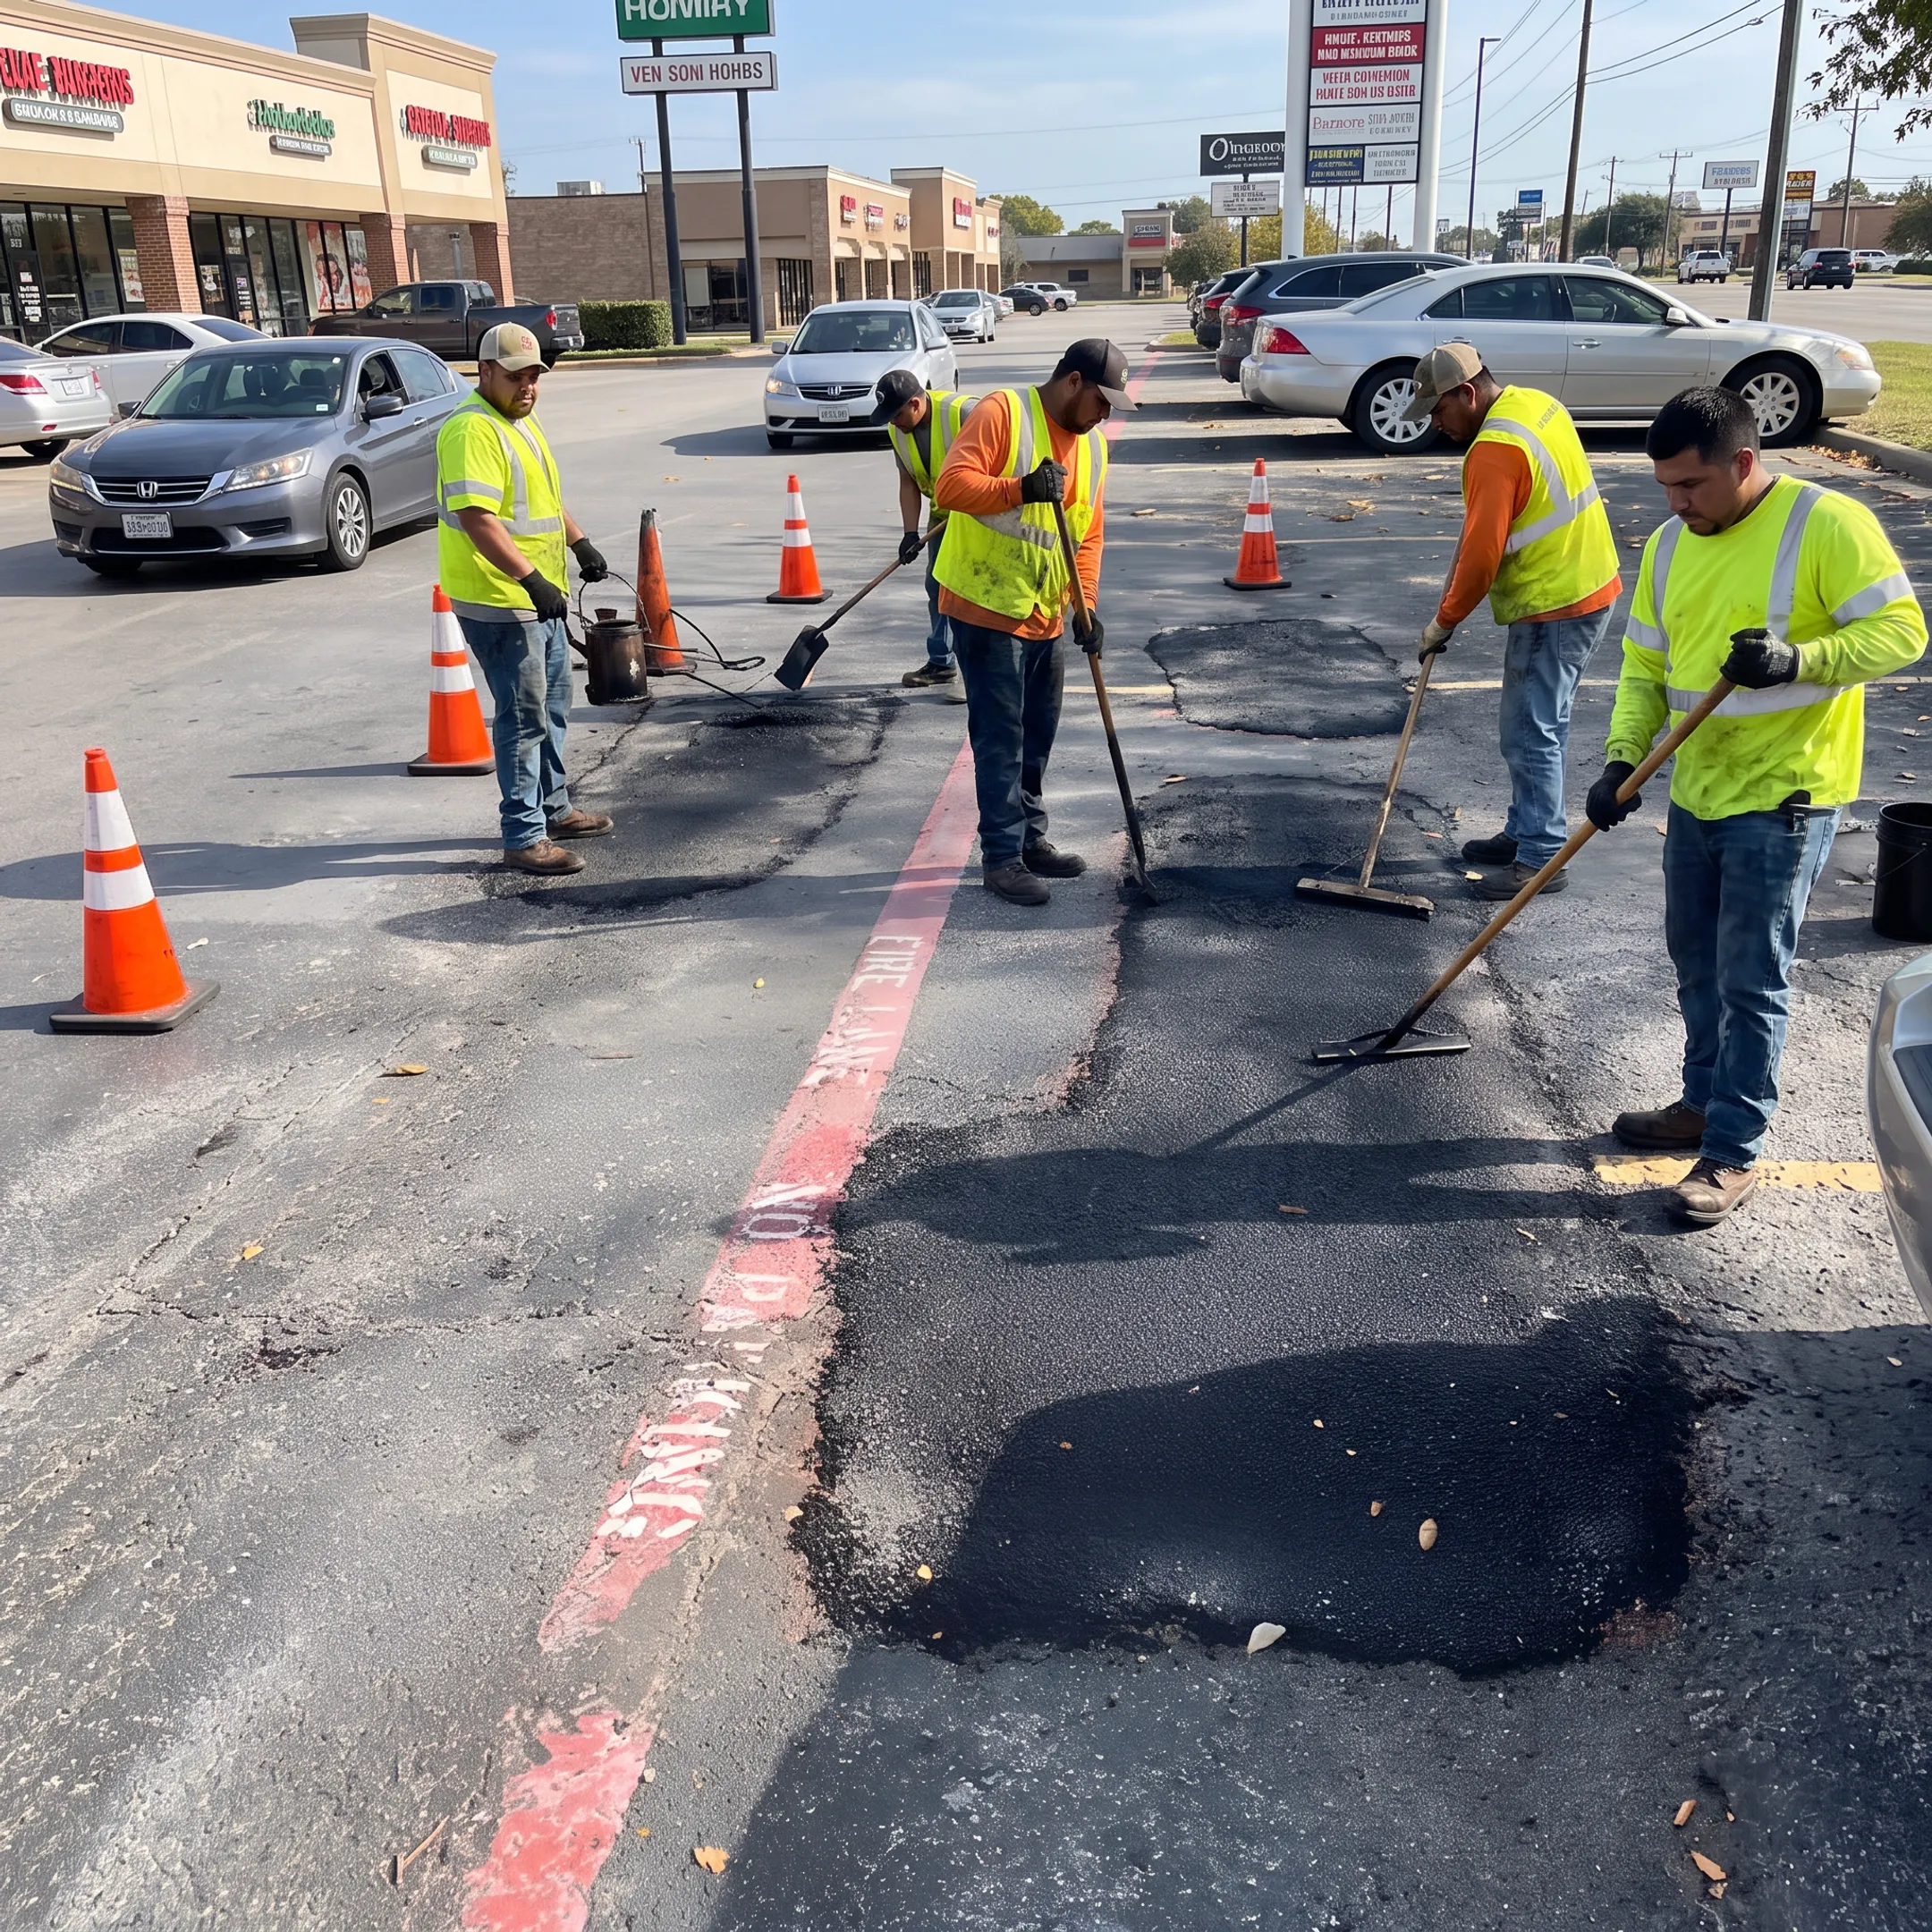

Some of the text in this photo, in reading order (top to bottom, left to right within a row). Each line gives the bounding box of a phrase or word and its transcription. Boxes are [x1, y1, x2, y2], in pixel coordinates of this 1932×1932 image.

[631, 62, 763, 82] VEN SONI HOHBS
[851, 935, 924, 992] FIRE
[740, 1182, 828, 1240] NO
